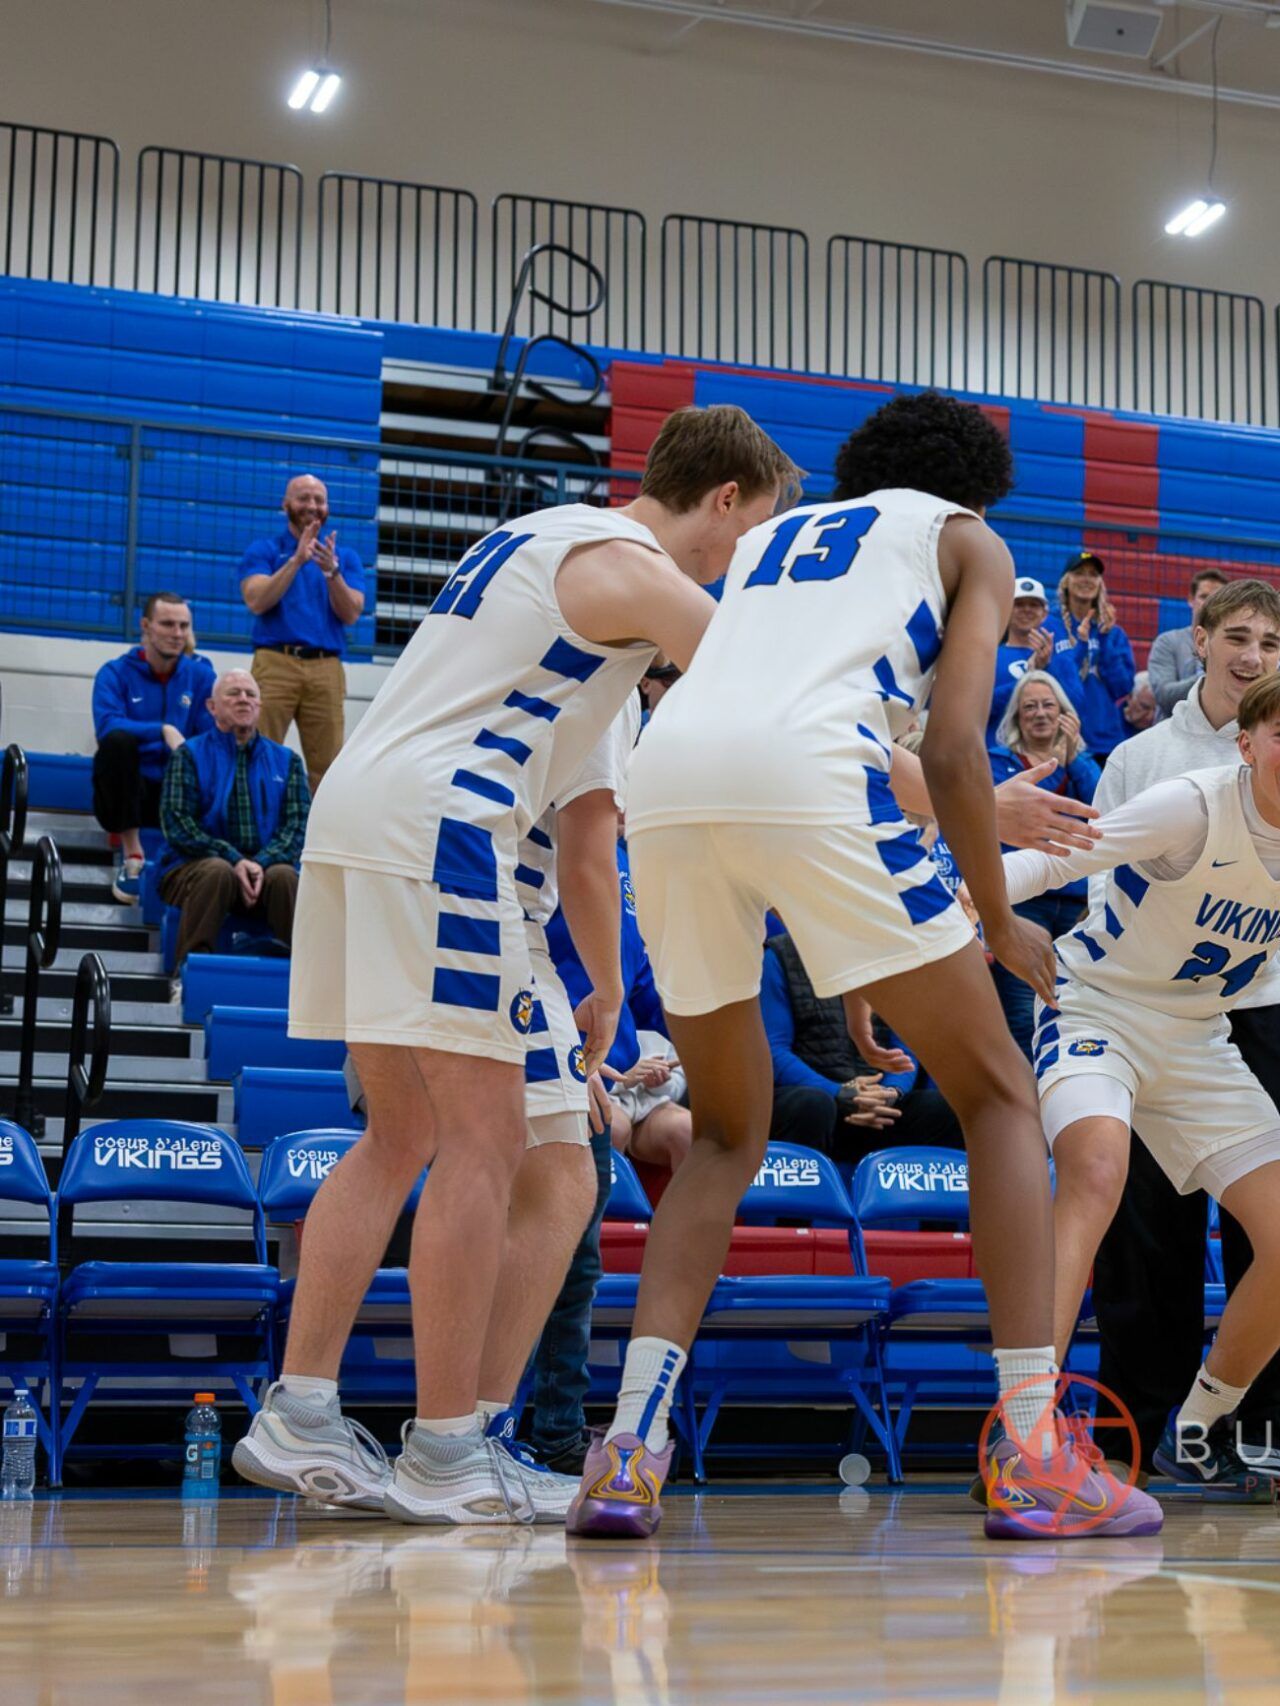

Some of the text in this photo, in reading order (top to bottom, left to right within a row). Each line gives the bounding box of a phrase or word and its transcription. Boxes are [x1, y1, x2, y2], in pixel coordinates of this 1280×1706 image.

[743, 506, 881, 590] 13
[429, 530, 537, 620] 21
[94, 1147, 223, 1170] VIKINGS
[878, 1171, 969, 1191] VIKING
[186, 1444, 198, 1462] G
